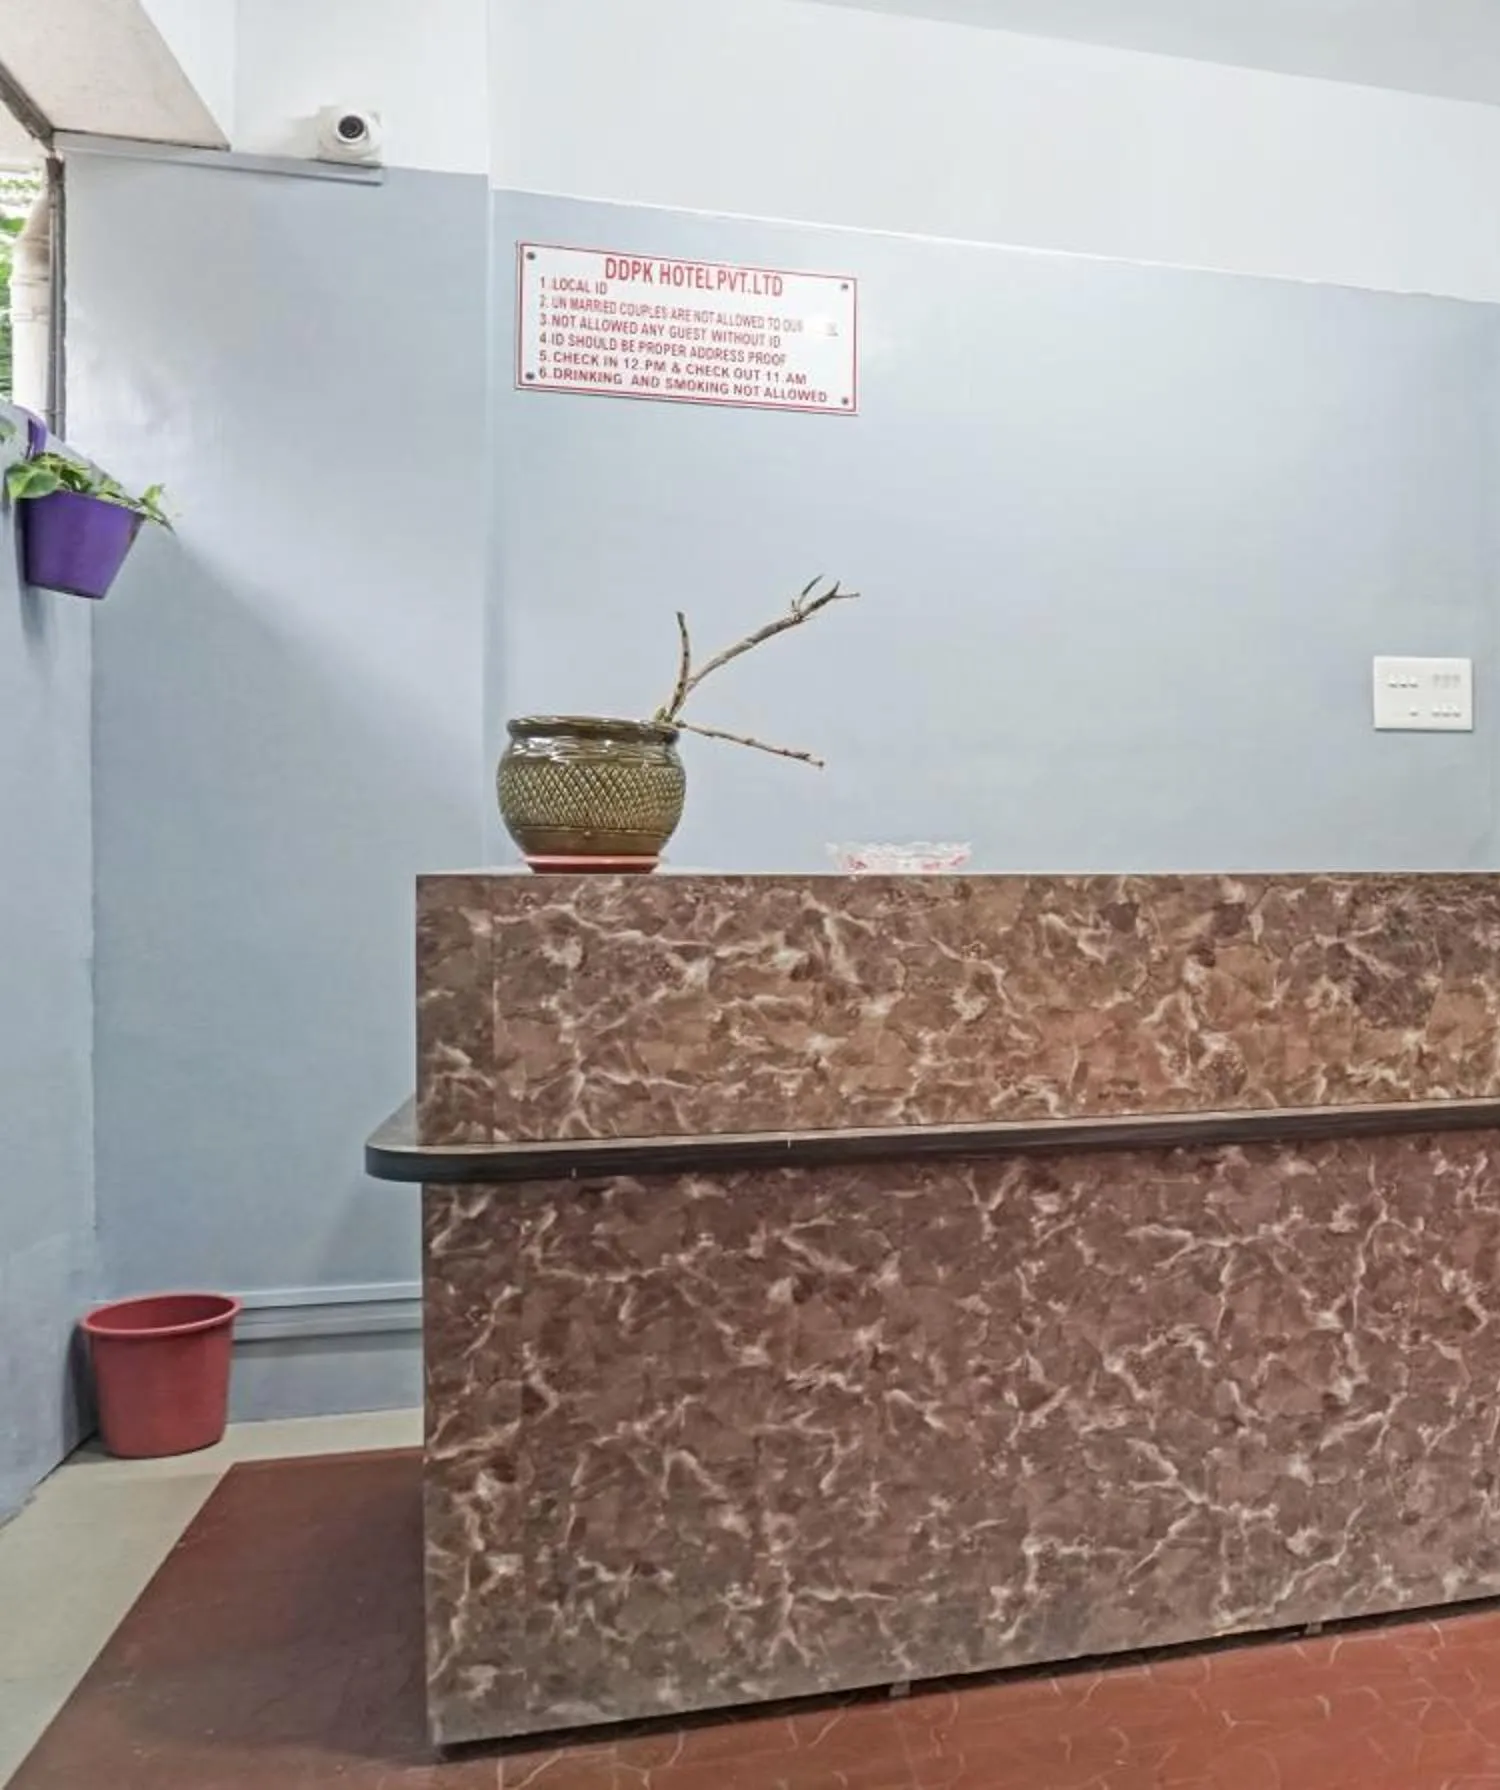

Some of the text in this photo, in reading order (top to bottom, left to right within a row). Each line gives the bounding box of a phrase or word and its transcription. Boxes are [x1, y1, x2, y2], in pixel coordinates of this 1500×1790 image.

[596, 281, 608, 295] ID
[606, 258, 653, 282] DDPK
[660, 264, 714, 289] HOTEL
[580, 316, 638, 334] ALLOWED
[641, 323, 664, 336] ANY
[669, 325, 706, 341] GUEST
[712, 329, 765, 346] WITHOUT
[770, 335, 781, 348] ID
[671, 307, 692, 321] ARE
[694, 310, 714, 323] NOT
[716, 313, 764, 328] ALLOWED
[768, 317, 780, 330] TO
[568, 334, 617, 350] SHOULD
[621, 339, 635, 352] BE
[638, 340, 686, 358] PROPER
[690, 346, 744, 363] ADDRESS
[748, 351, 787, 366] PROOF
[604, 356, 618, 367] IN
[671, 361, 681, 374] &
[686, 363, 730, 378] CHECK
[733, 368, 761, 381] OUT
[631, 374, 660, 388] AND
[666, 377, 729, 394] SMOKING
[734, 383, 760, 396] NOT
[764, 387, 827, 403] ALLOWED
